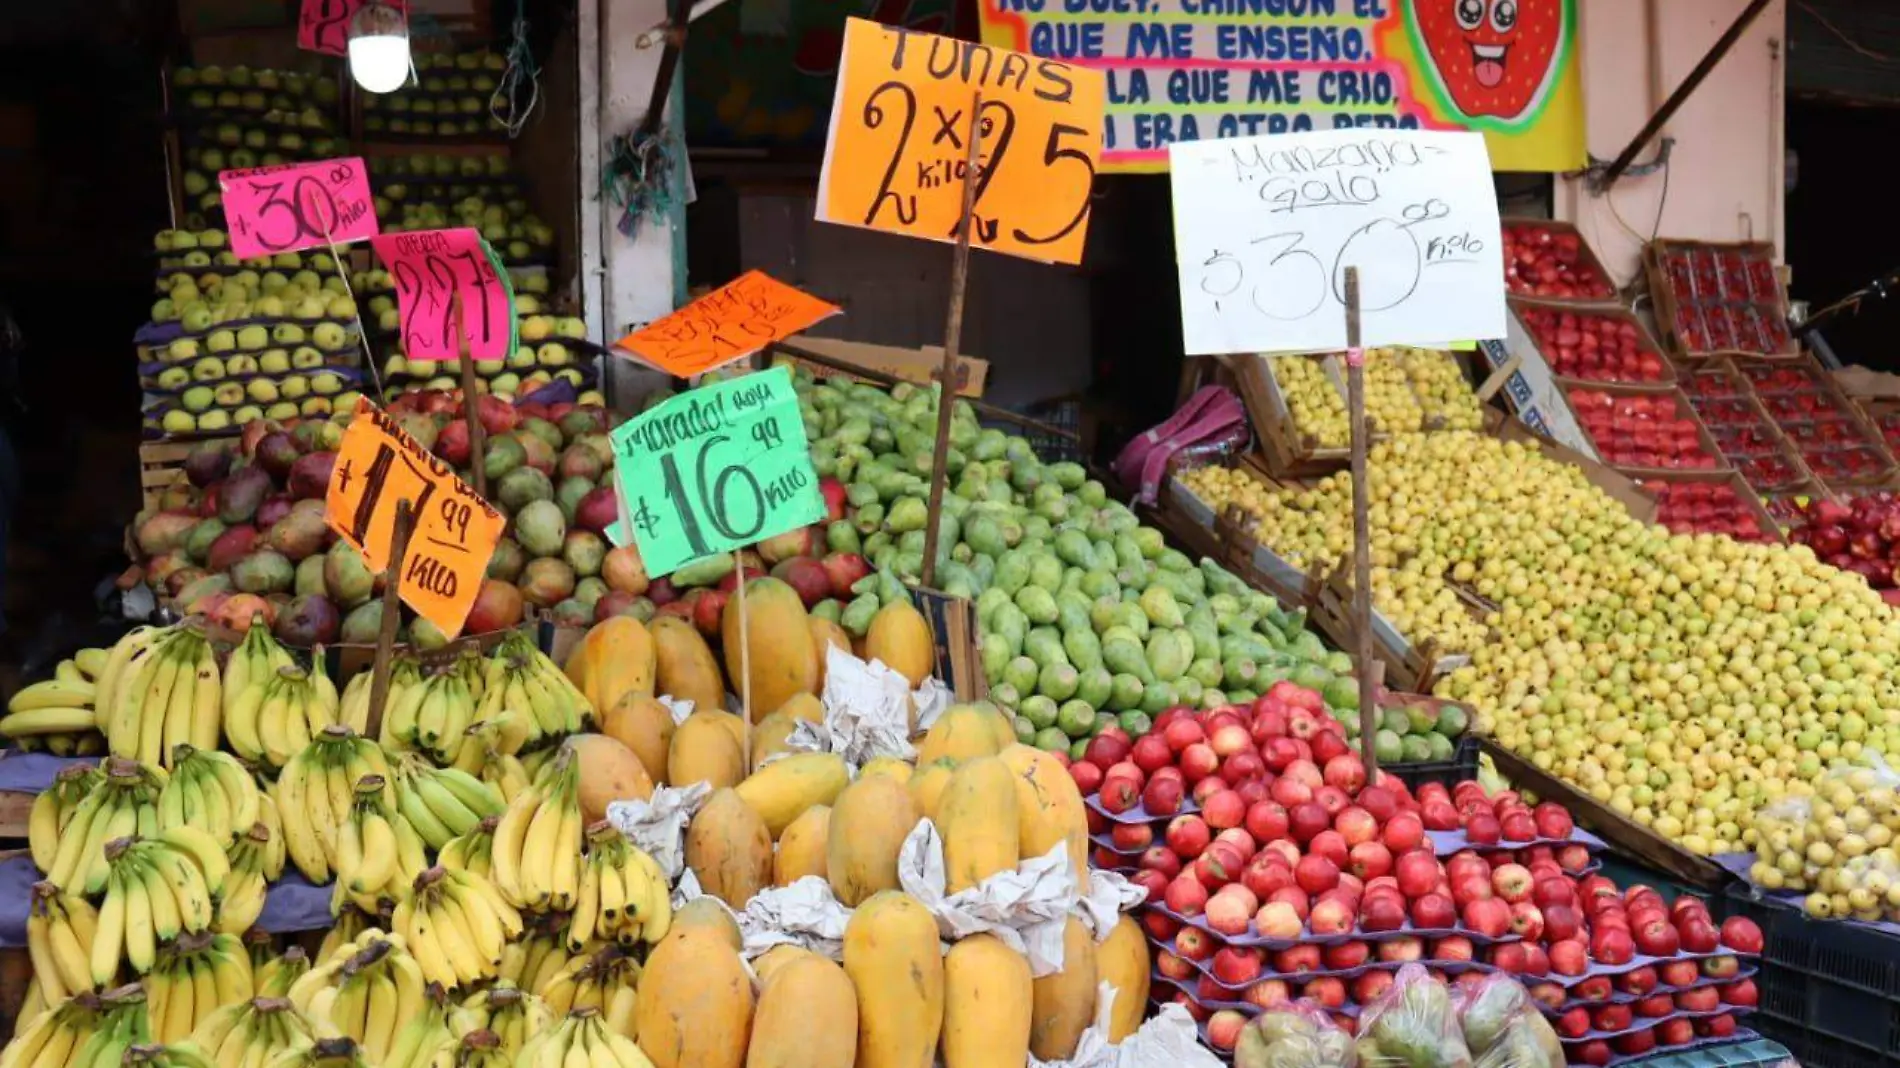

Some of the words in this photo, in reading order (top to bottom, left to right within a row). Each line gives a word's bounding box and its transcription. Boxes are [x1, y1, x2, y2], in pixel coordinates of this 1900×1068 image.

[1031, 21, 1104, 58] QUE
[1126, 23, 1193, 60] ME
[1107, 68, 1150, 104] LA
[1168, 69, 1230, 105] QUE
[1247, 70, 1300, 105] ME
[1134, 113, 1199, 149] ERA
[1260, 170, 1381, 213] Gala
